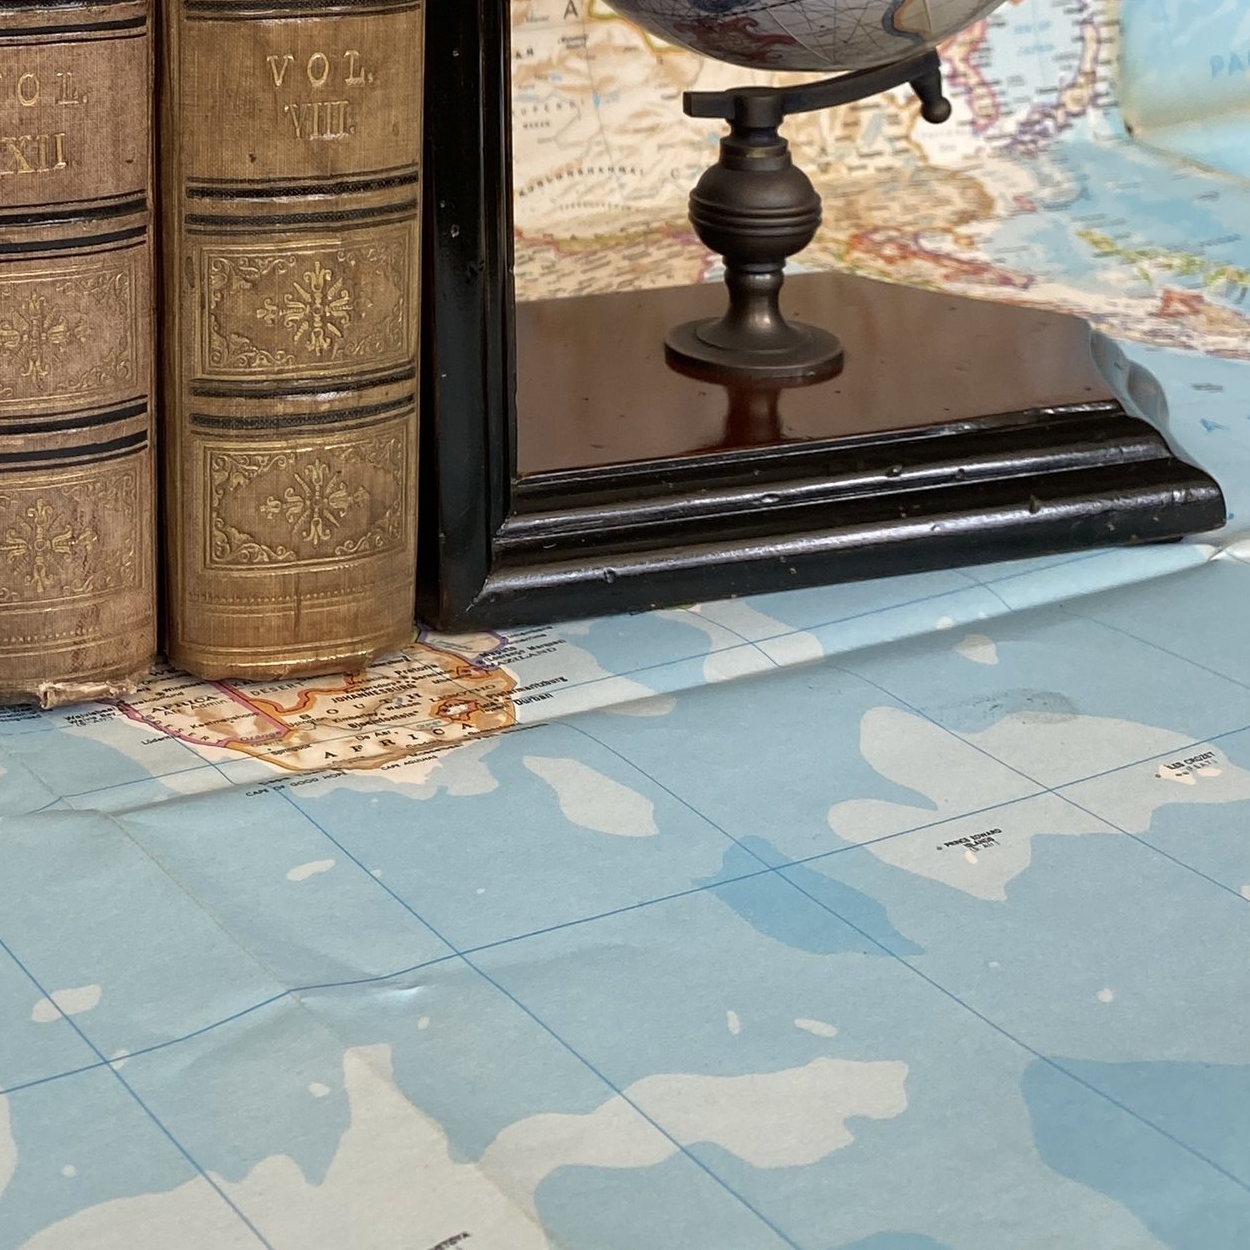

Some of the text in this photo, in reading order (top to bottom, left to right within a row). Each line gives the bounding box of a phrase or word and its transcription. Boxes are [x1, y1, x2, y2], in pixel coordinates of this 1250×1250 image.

[250, 681, 304, 697] DESERT
[331, 683, 418, 704] JOHANNESBURG
[513, 692, 554, 707] Durban
[245, 788, 268, 798] CAPE
[290, 777, 320, 788] GOOD
